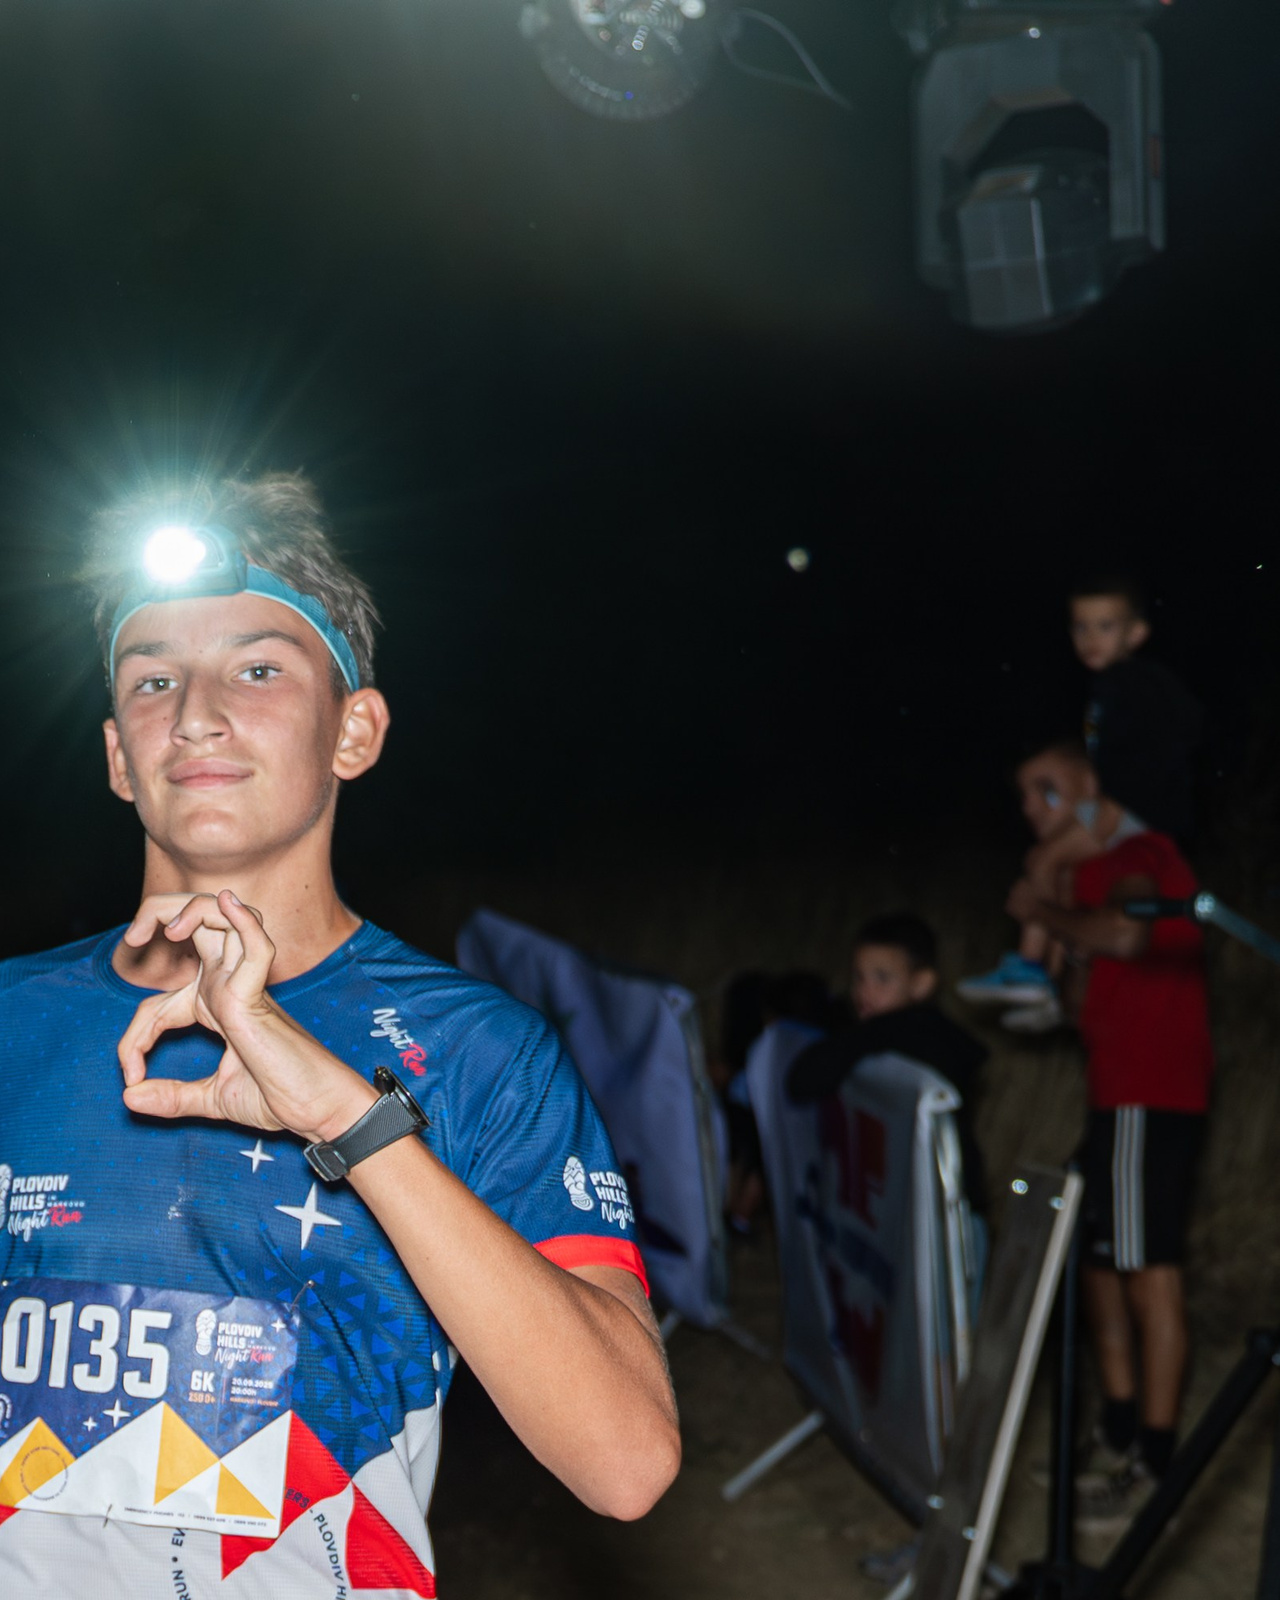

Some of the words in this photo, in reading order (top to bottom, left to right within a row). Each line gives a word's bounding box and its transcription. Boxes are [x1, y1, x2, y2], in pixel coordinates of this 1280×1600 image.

[370, 1008, 414, 1049] Night
[399, 1043, 427, 1076] Run
[12, 1174, 69, 1193] PLOVDIV
[10, 1194, 46, 1211] HILLS
[595, 1186, 629, 1206] HILLS
[7, 1209, 49, 1242] Night
[48, 1205, 83, 1227] Run
[218, 1322, 263, 1338] PLOVDIV
[0, 1297, 173, 1399] 0135
[217, 1335, 246, 1349] HILLS
[214, 1348, 250, 1370] Night
[190, 1369, 215, 1392] 6K
[283, 1486, 309, 1509] ERS
[171, 1527, 187, 1547] EV
[313, 1513, 344, 1581] PLOVDIV
